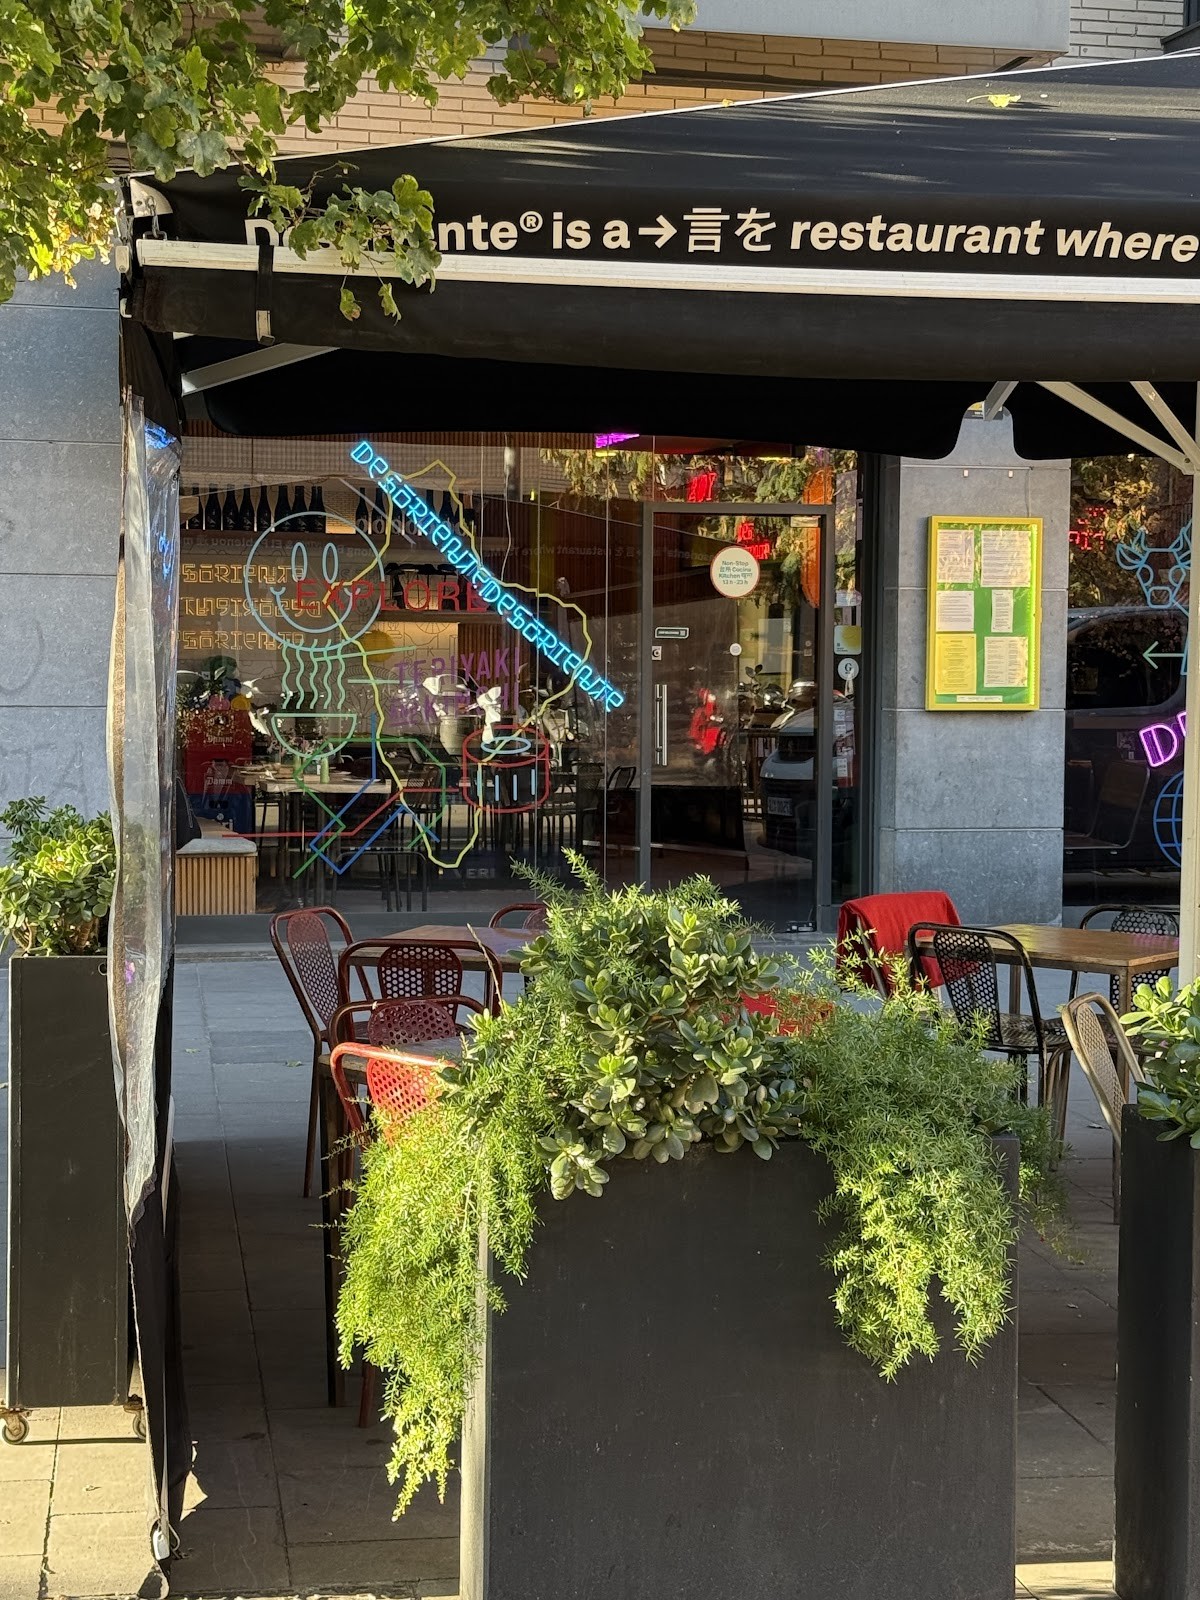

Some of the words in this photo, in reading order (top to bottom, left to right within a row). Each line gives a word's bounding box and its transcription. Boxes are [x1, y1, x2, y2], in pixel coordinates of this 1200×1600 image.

[552, 212, 591, 250] is
[603, 219, 631, 250] a
[683, 207, 776, 253] 言を
[790, 214, 1044, 256] restaurant
[1056, 221, 1199, 263] where
[296, 578, 489, 613] EXPLORE
